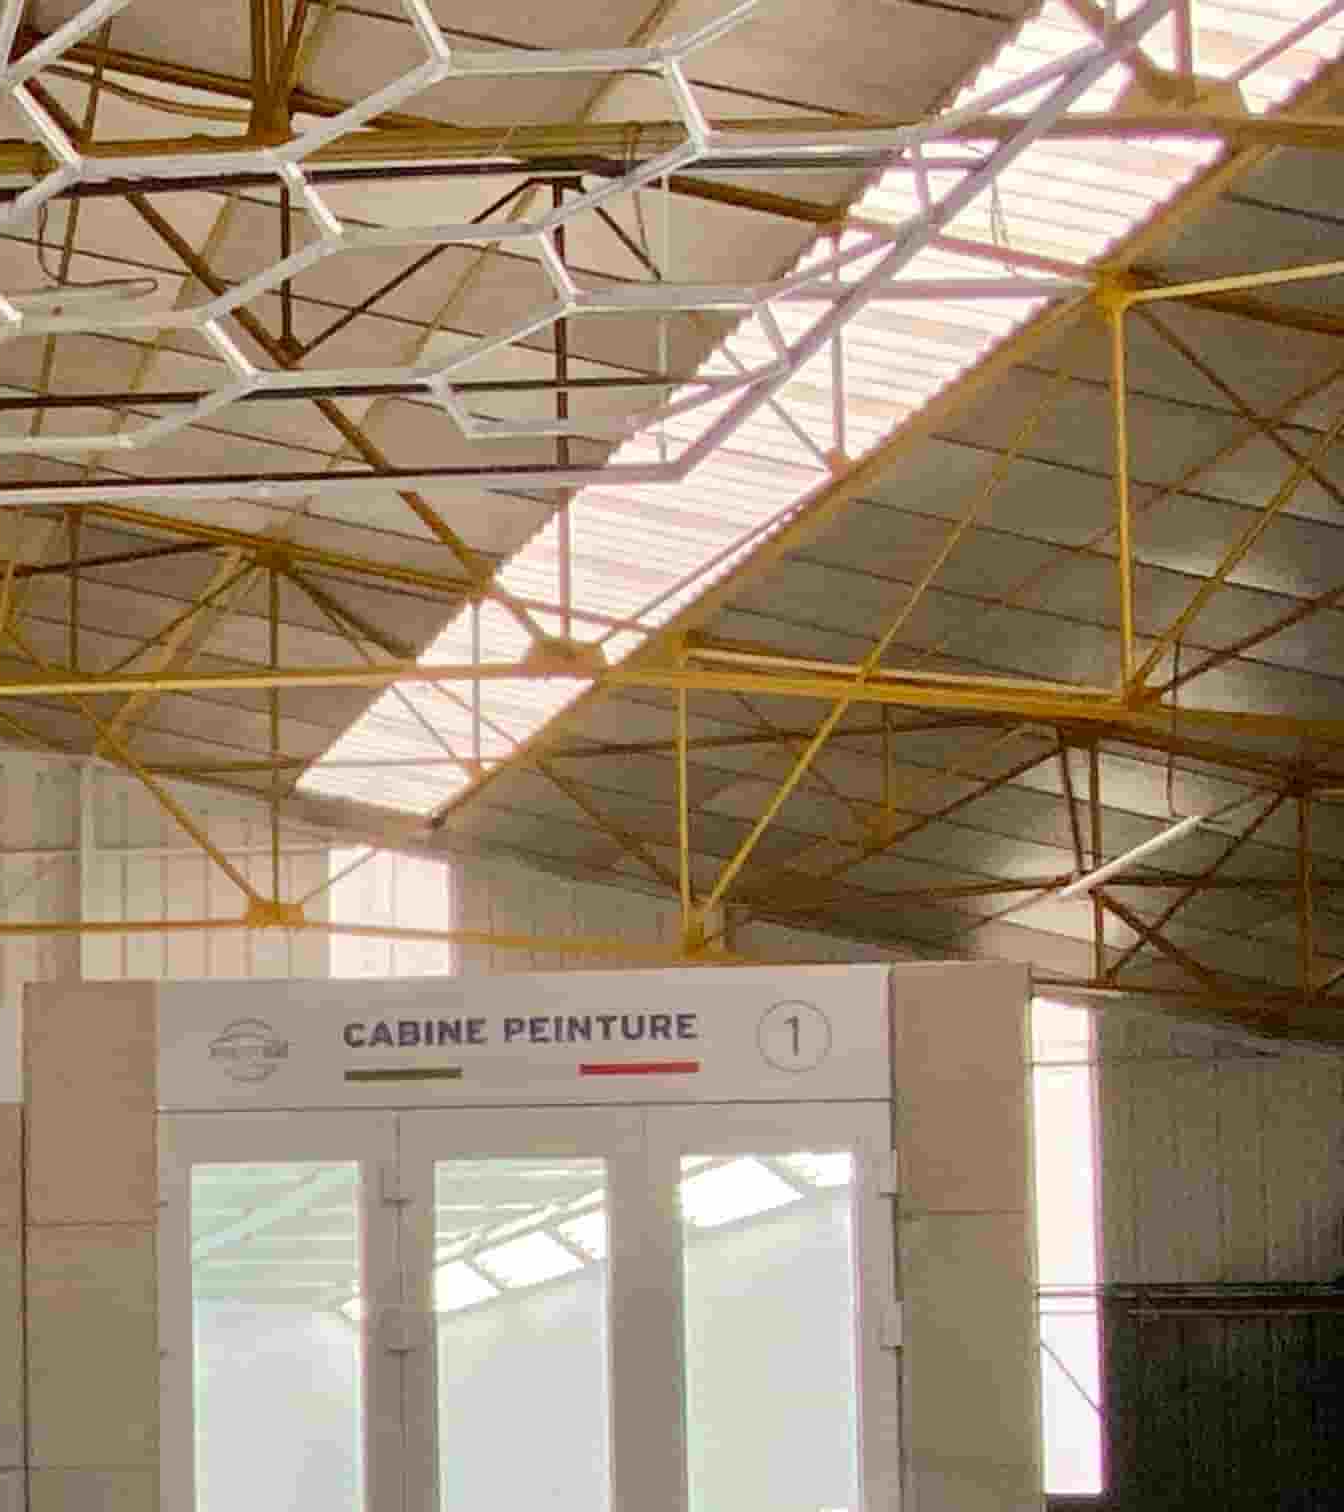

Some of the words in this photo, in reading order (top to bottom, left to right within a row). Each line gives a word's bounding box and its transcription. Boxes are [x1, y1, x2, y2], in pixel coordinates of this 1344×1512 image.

[343, 1018, 489, 1048] CABINE
[503, 1014, 698, 1044] PEINTURE
[783, 1016, 800, 1057] 1
